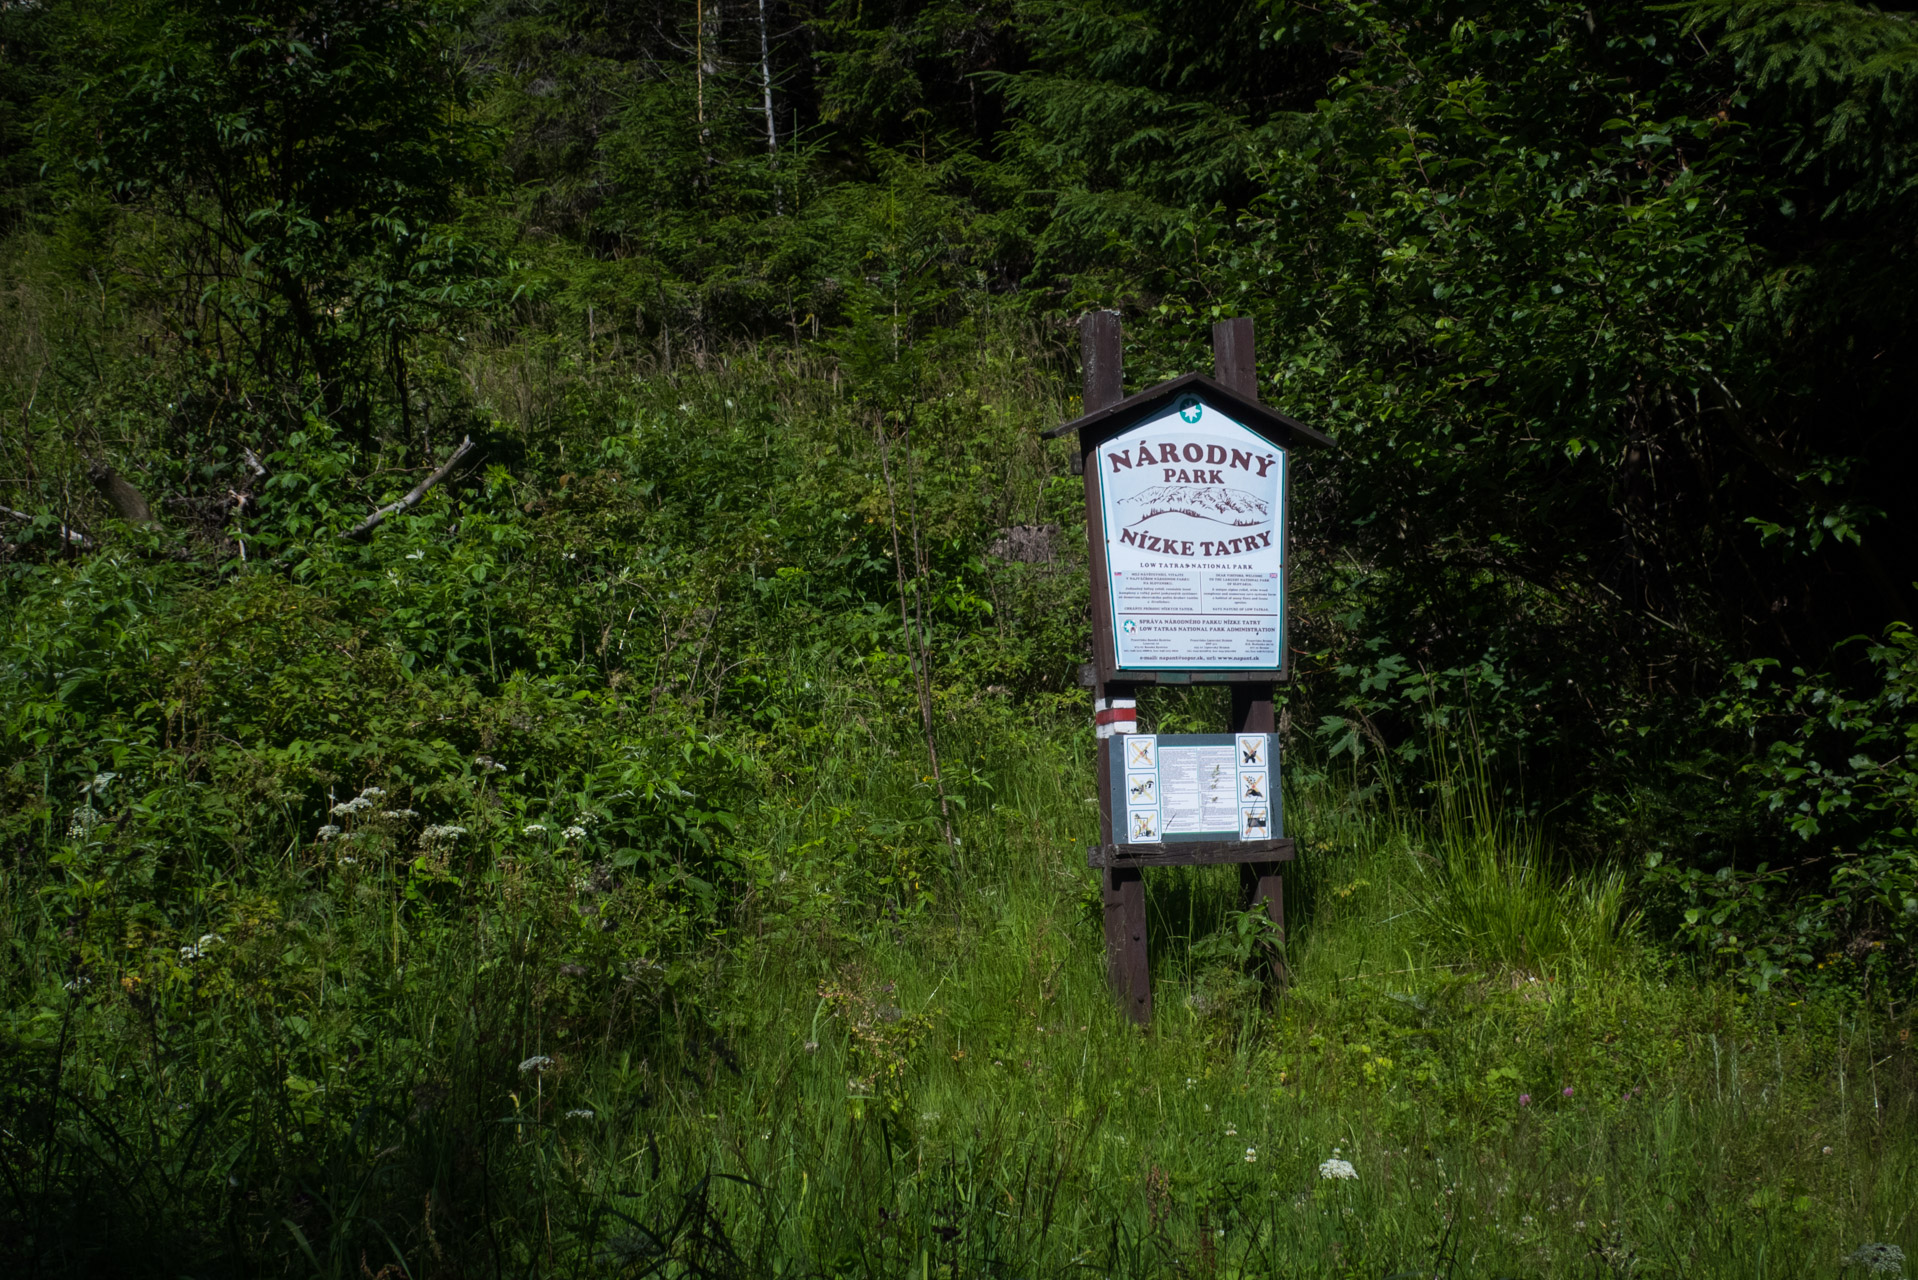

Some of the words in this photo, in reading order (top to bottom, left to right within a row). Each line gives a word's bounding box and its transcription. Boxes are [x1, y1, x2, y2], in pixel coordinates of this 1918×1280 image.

[1108, 440, 1276, 478] NÁRODNÝ
[1163, 468, 1224, 484] PARK
[1120, 528, 1194, 556] NÍZKE
[1200, 530, 1272, 556] TATRY
